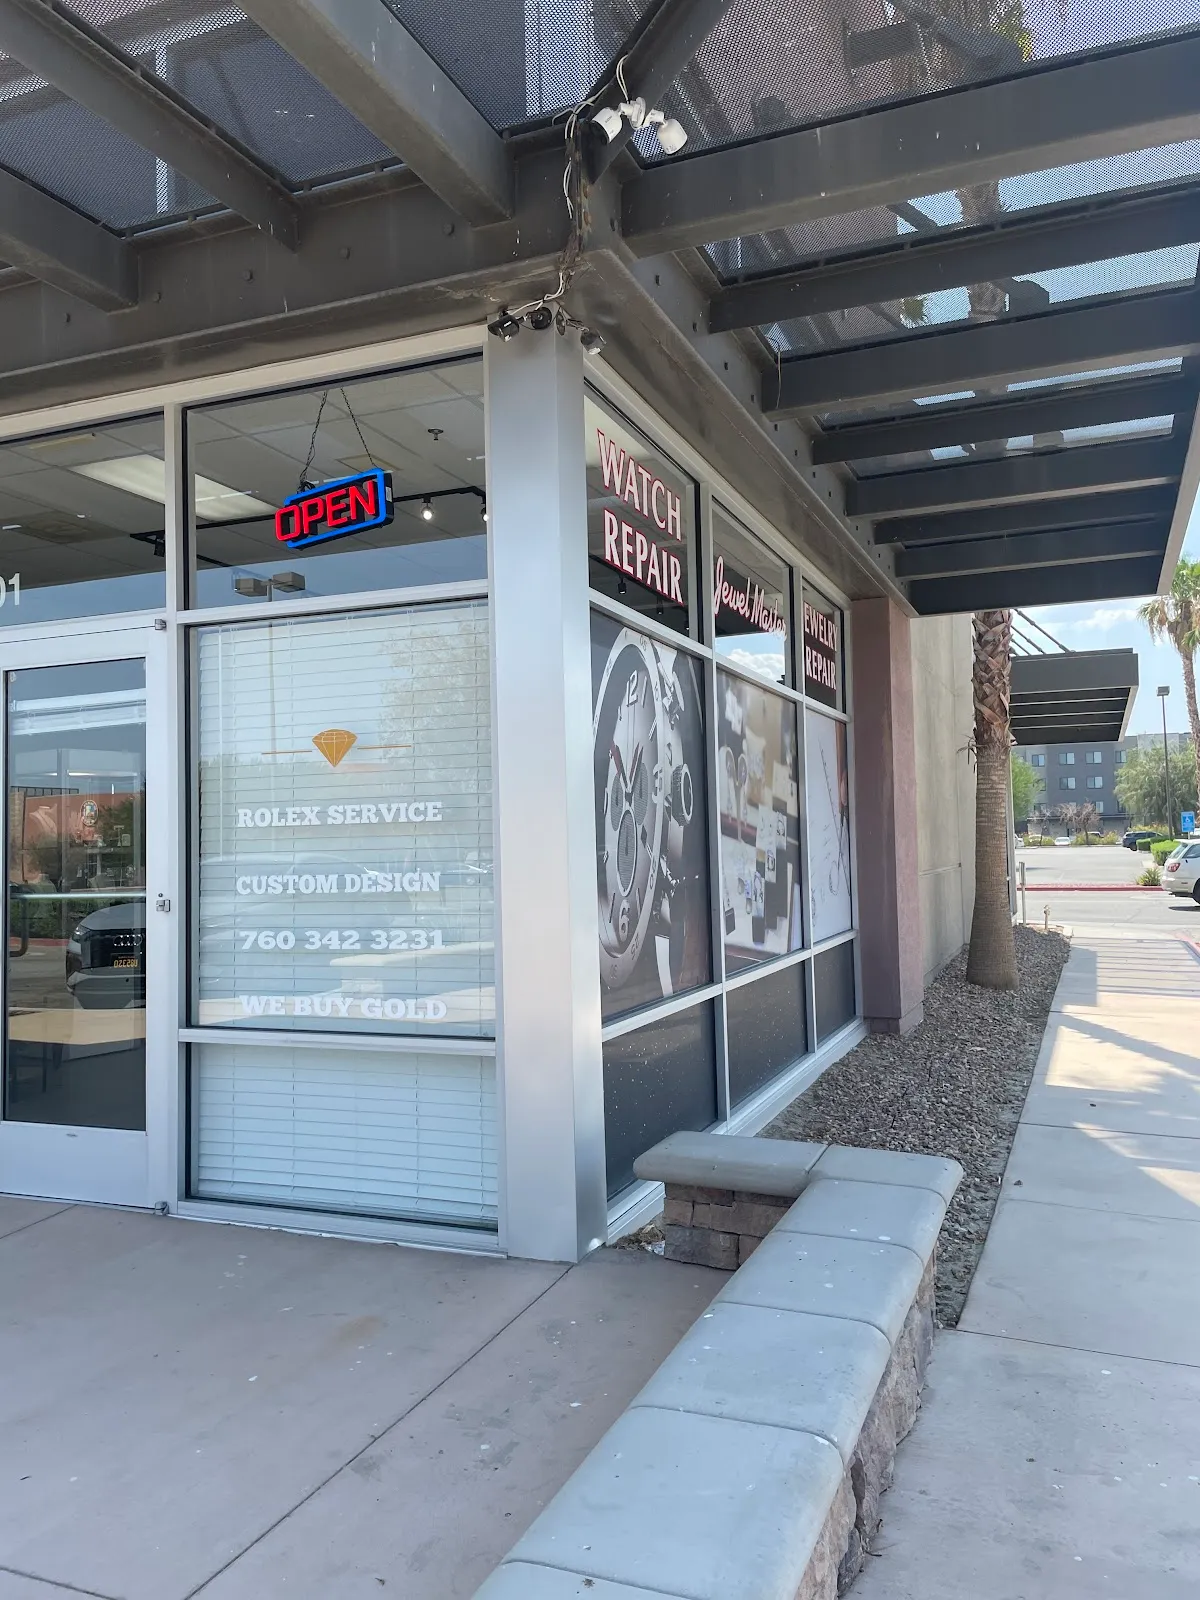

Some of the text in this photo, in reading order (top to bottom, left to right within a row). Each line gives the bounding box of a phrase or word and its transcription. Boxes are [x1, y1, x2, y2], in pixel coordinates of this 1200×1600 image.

[597, 428, 682, 541] WATCH
[275, 480, 376, 541] OPEN
[604, 508, 684, 607] REPAIR
[714, 556, 787, 642] Jewel Master
[805, 645, 837, 690] REPAIR
[237, 801, 443, 828] ROLEX SERVICE
[236, 871, 441, 895] CUSTOM DESIGN
[239, 929, 446, 950] 760 342 3231
[239, 995, 447, 1020] WE BUY GOLD
